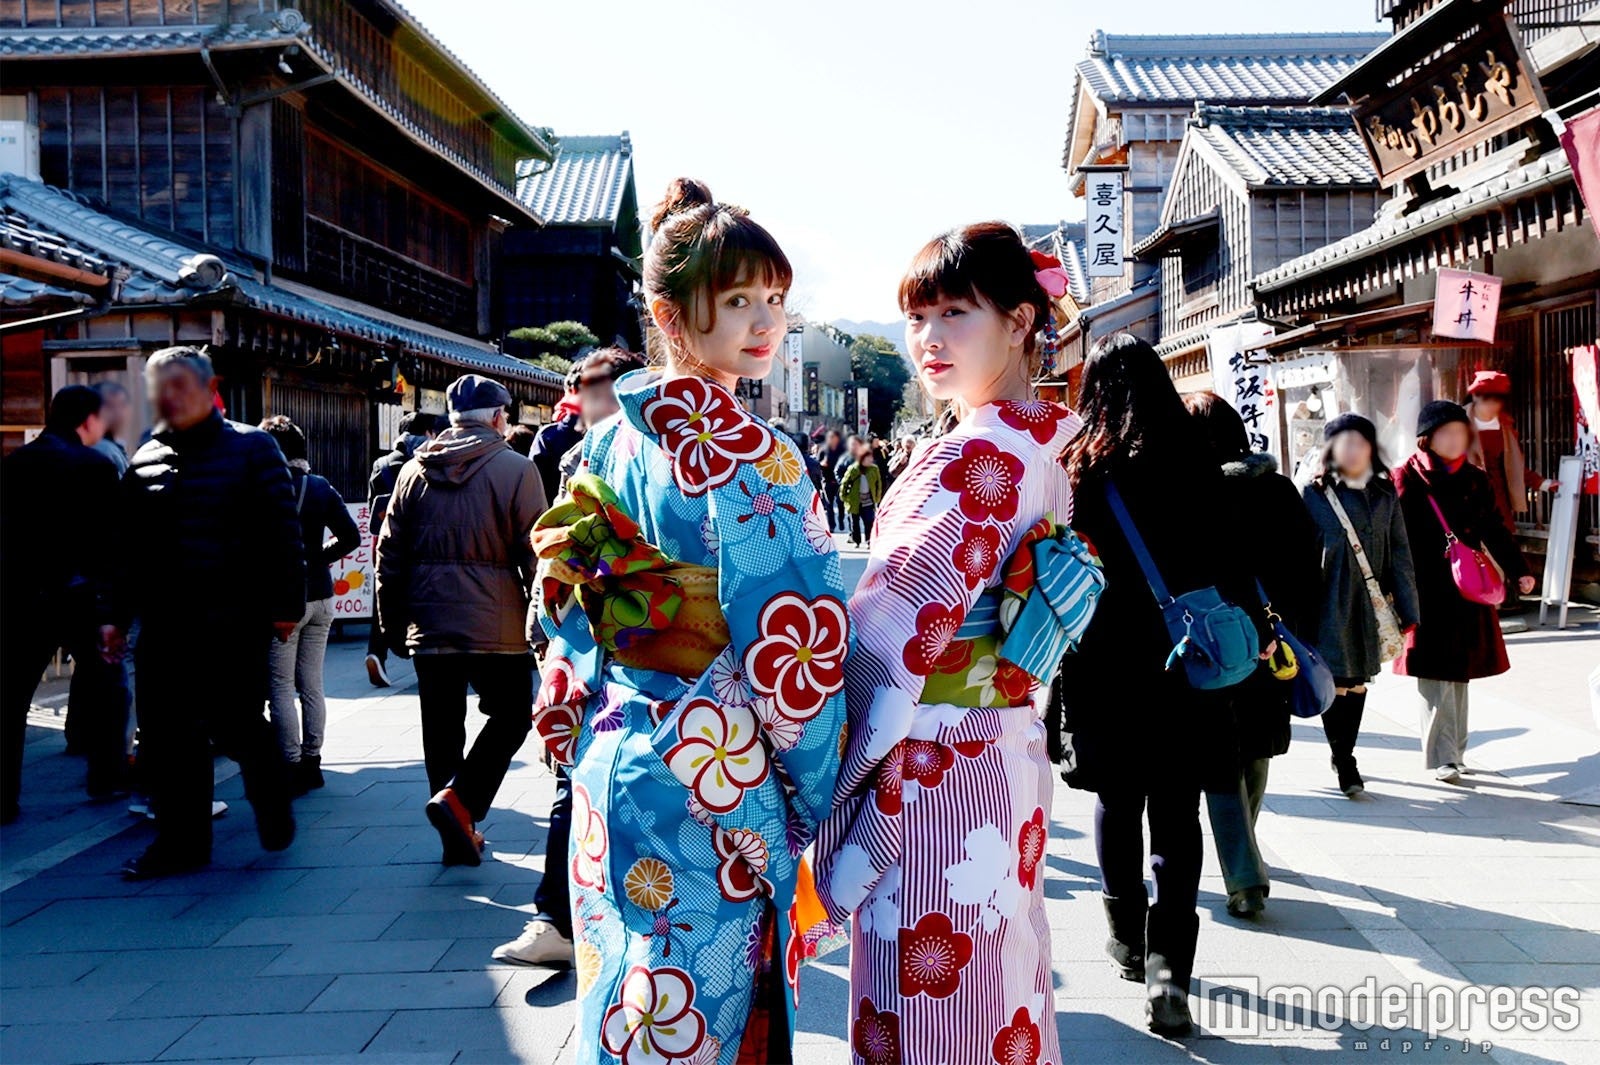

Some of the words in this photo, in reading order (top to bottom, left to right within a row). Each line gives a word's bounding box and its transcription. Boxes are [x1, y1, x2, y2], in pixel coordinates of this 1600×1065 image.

[1092, 183, 1119, 266] 喜久屋
[1454, 280, 1478, 330] 牛丼
[1228, 351, 1270, 452] 松阪牛肉
[355, 507, 371, 563] まるごと
